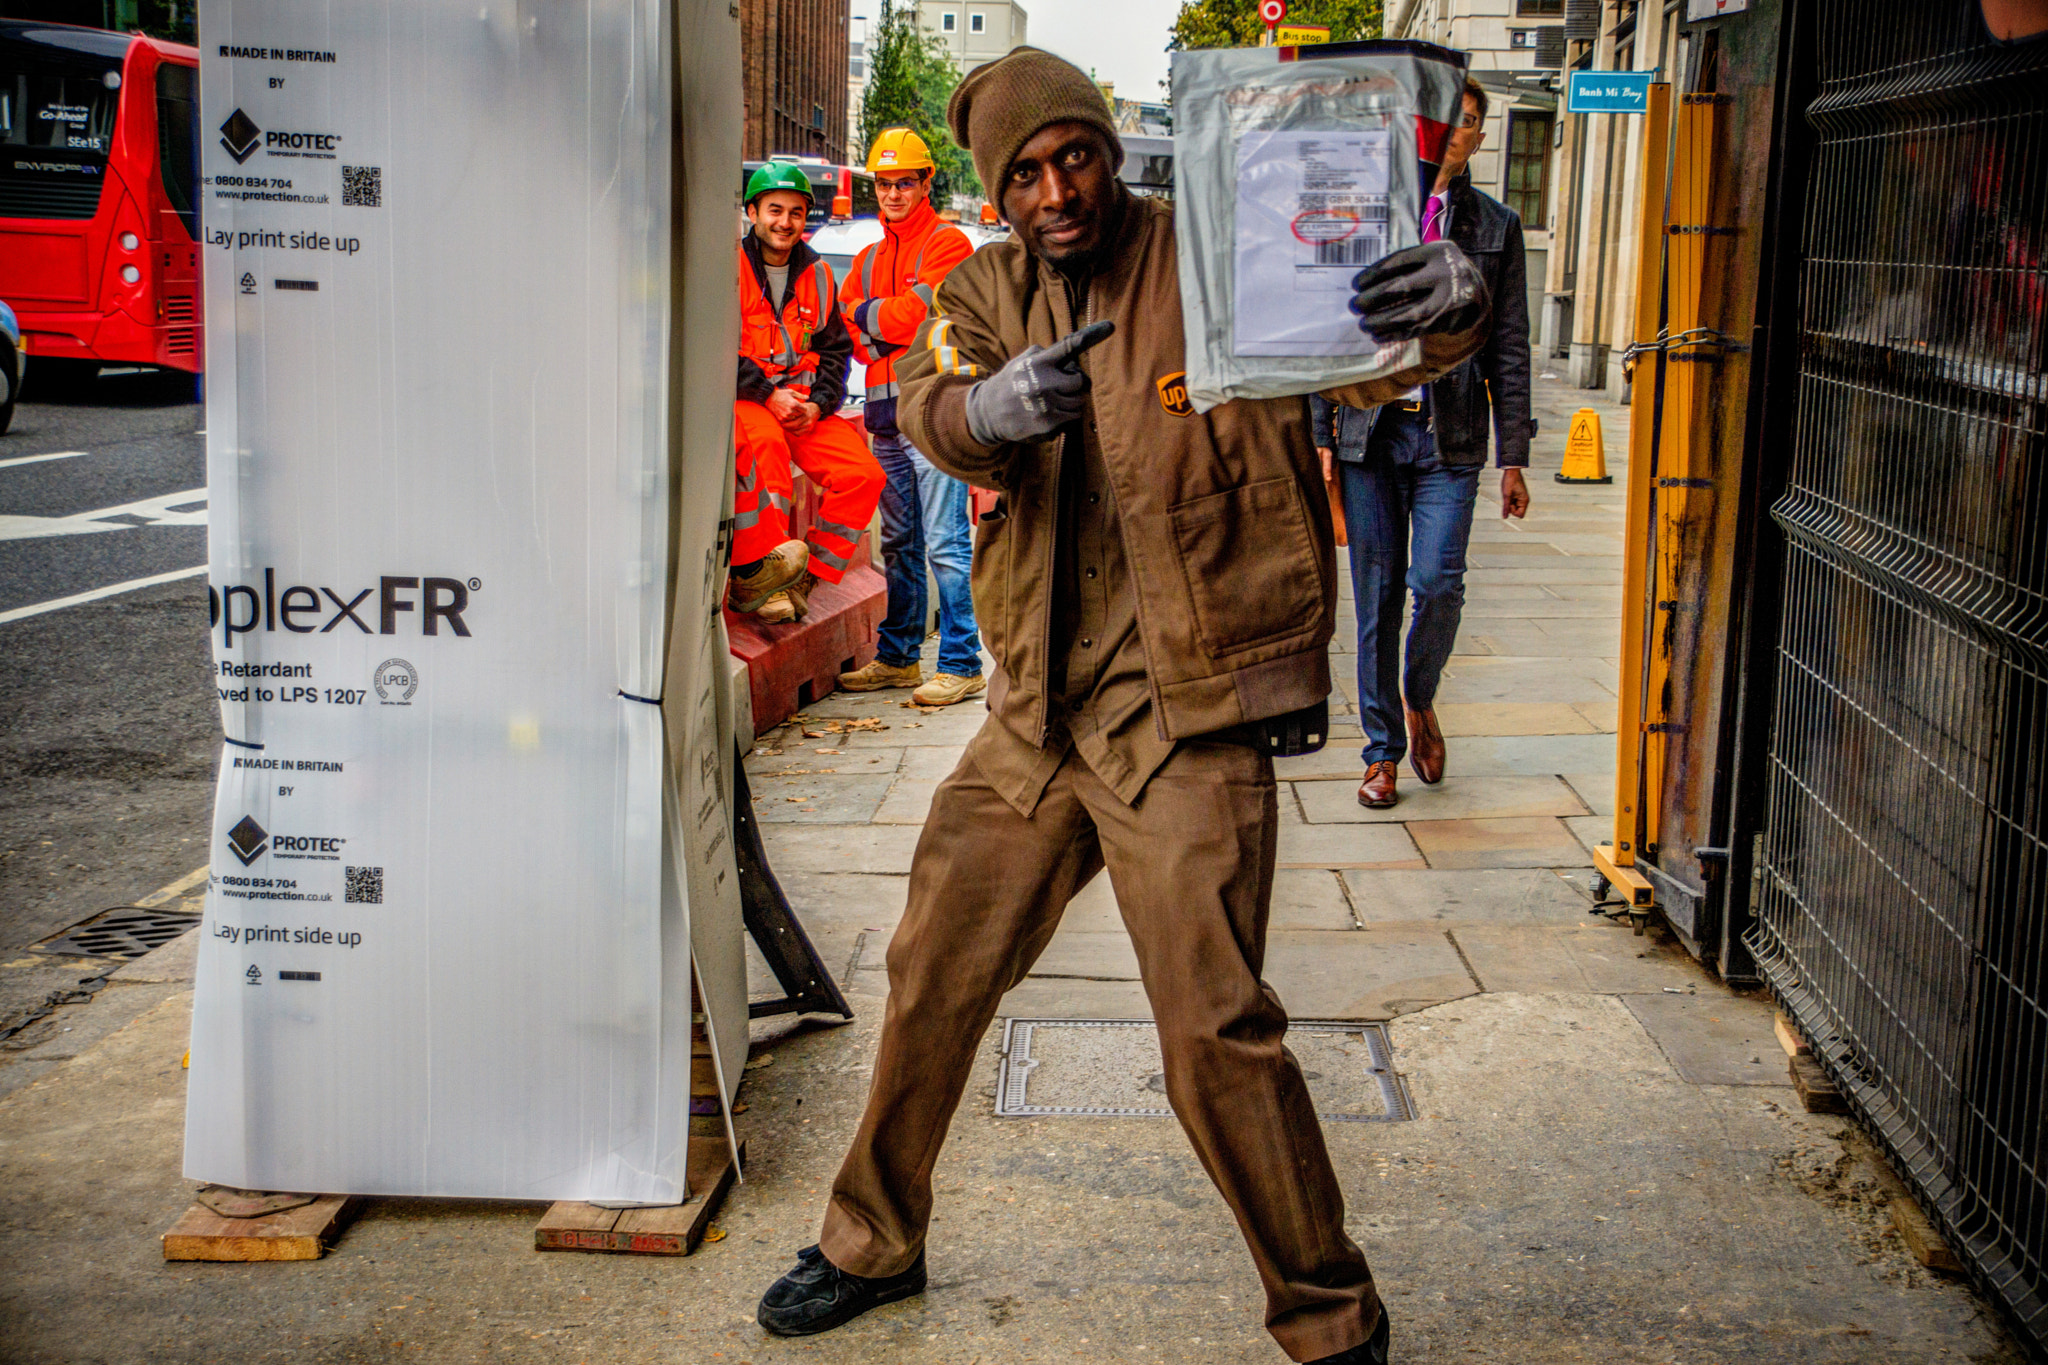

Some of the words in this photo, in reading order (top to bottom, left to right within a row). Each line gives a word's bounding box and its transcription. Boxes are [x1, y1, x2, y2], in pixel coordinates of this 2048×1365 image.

[1283, 32, 1299, 40] Bus
[1301, 34, 1321, 43] stop
[230, 46, 268, 59] MADE
[270, 48, 284, 60] IN
[286, 50, 336, 63] BRITAIN
[269, 77, 285, 89] BY
[1579, 87, 1602, 97] Banh
[1605, 87, 1618, 97] Mi
[39, 110, 89, 122] Go-Ahead
[67, 135, 101, 149] SEe15
[215, 175, 245, 187] 0800
[246, 177, 268, 188] 834
[270, 178, 292, 189] 704
[215, 189, 329, 204] www.protection.co.uk
[205, 226, 234, 249] Lay
[238, 228, 285, 250] print
[290, 230, 331, 251] side
[335, 237, 360, 256] up
[221, 660, 312, 679] Retardant
[383, 674, 409, 686] LPCB
[217, 686, 249, 702] ved
[255, 687, 273, 702] to
[280, 686, 318, 704] LPS
[324, 688, 367, 706] 1207
[243, 758, 279, 770] MADE
[281, 759, 294, 770] IN
[296, 760, 344, 772] BRITAIN
[278, 786, 294, 796] BY
[222, 875, 250, 887] 0800
[252, 878, 273, 888] 834
[275, 879, 297, 888] 704
[222, 889, 333, 903] www.protection.co.uk
[213, 920, 241, 943] Lay
[245, 924, 290, 944] print
[294, 926, 333, 944] side
[338, 930, 362, 949] up
